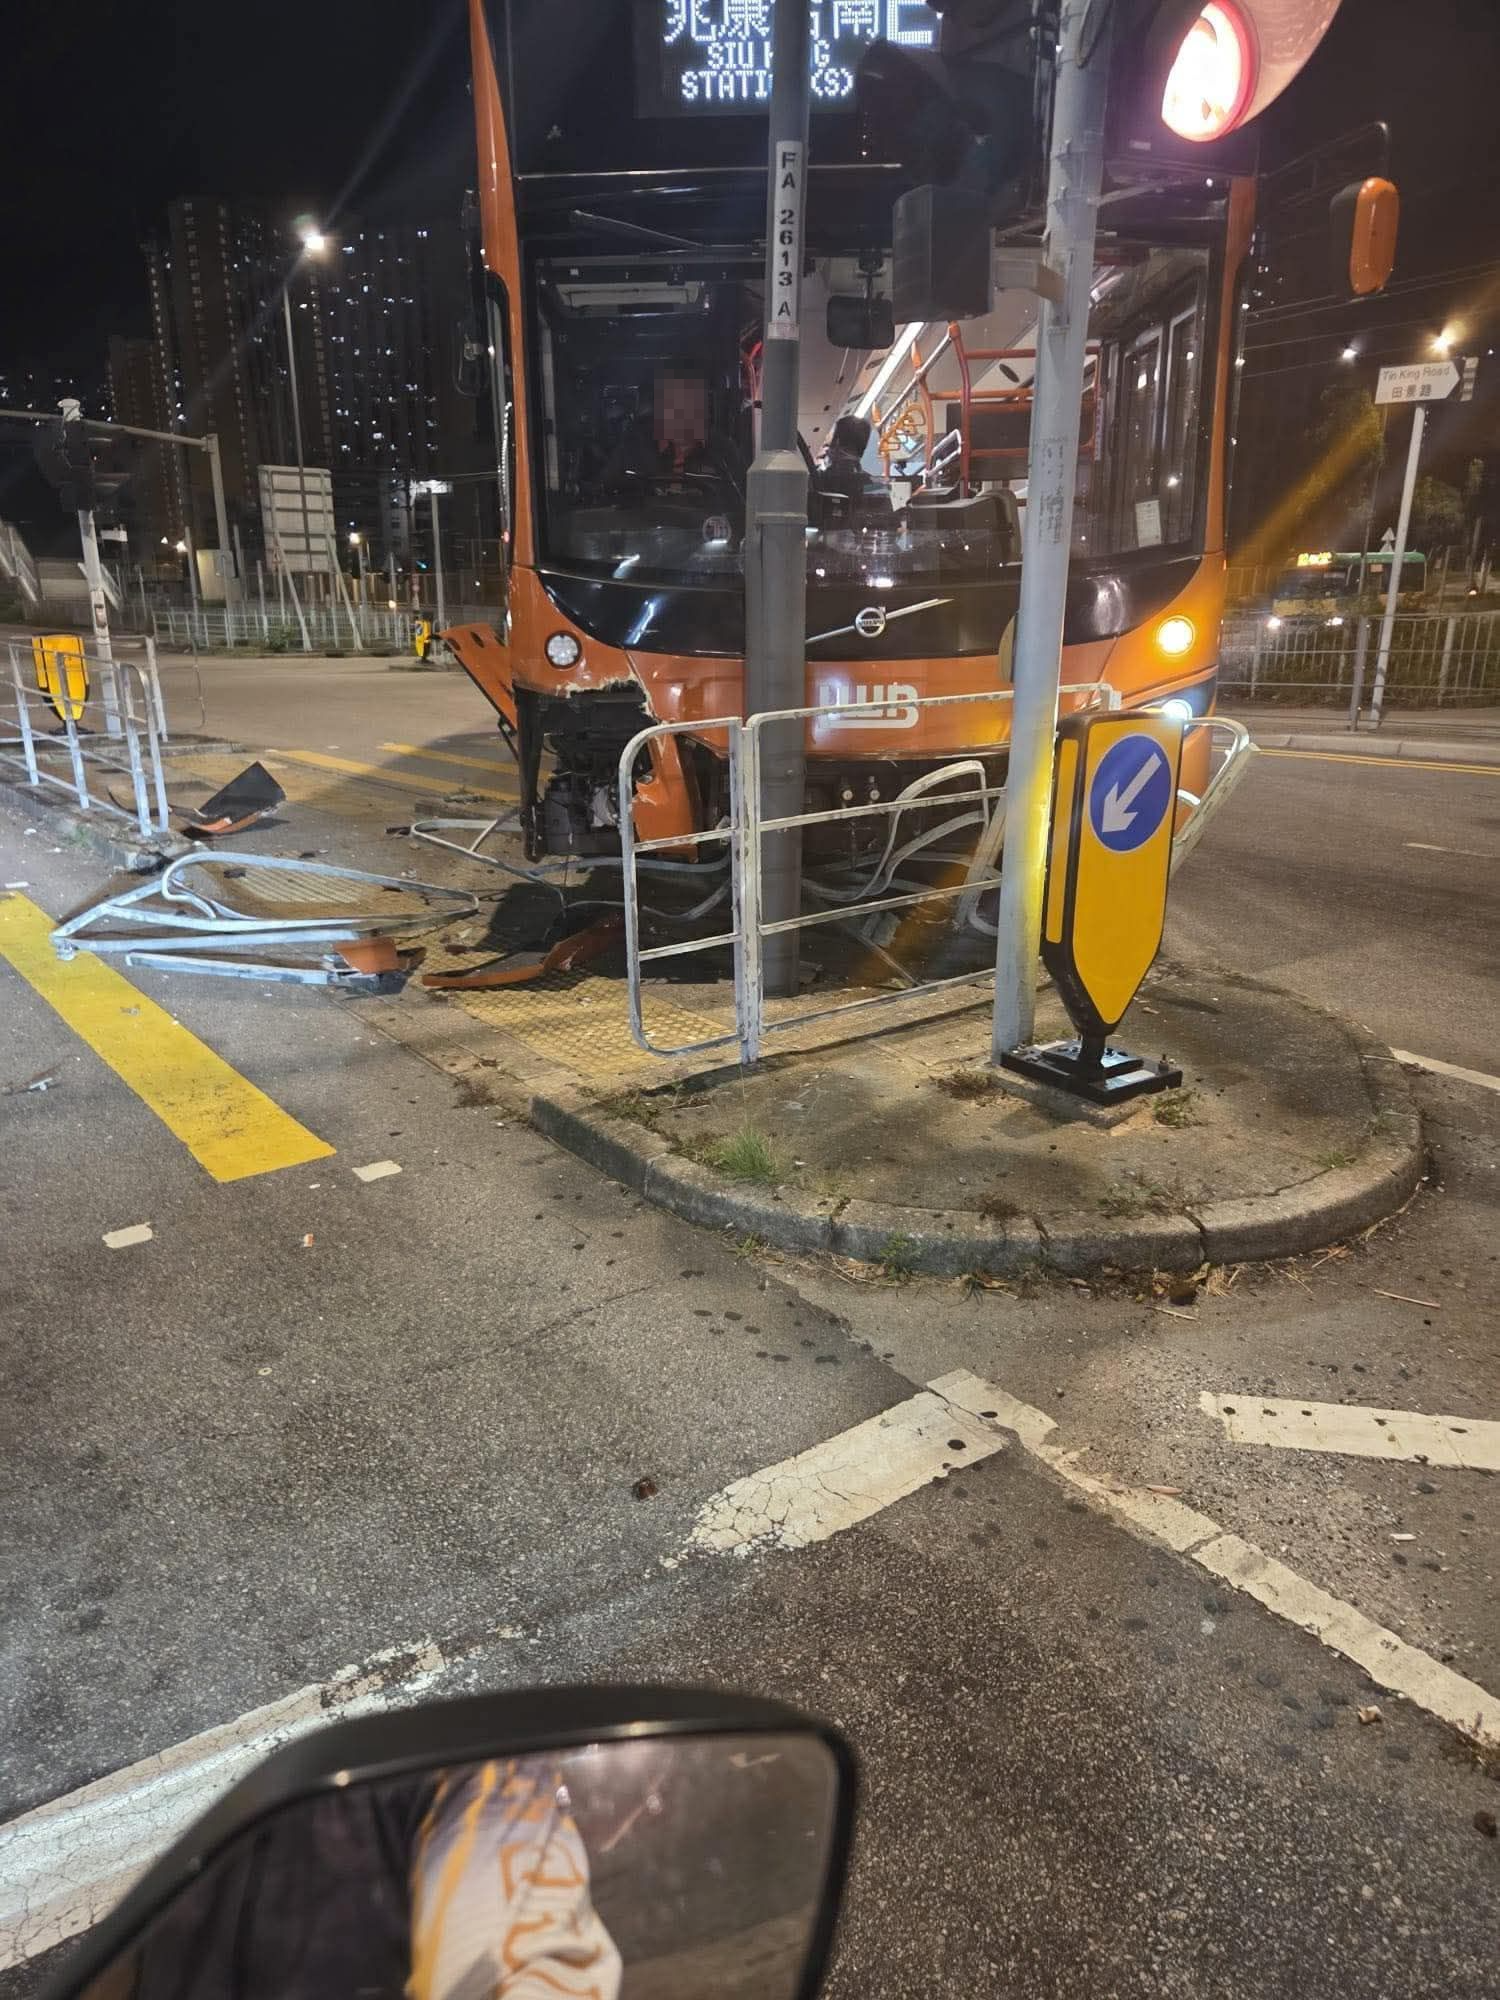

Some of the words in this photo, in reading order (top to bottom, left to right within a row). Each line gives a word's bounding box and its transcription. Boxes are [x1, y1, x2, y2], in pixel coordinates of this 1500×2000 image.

[708, 41, 752, 70] SIU
[682, 69, 773, 99] STATI
[810, 67, 854, 97] (S)
[780, 151, 797, 188] FA
[778, 208, 795, 287] 2613
[777, 300, 792, 316] A
[1423, 366, 1450, 377] Road
